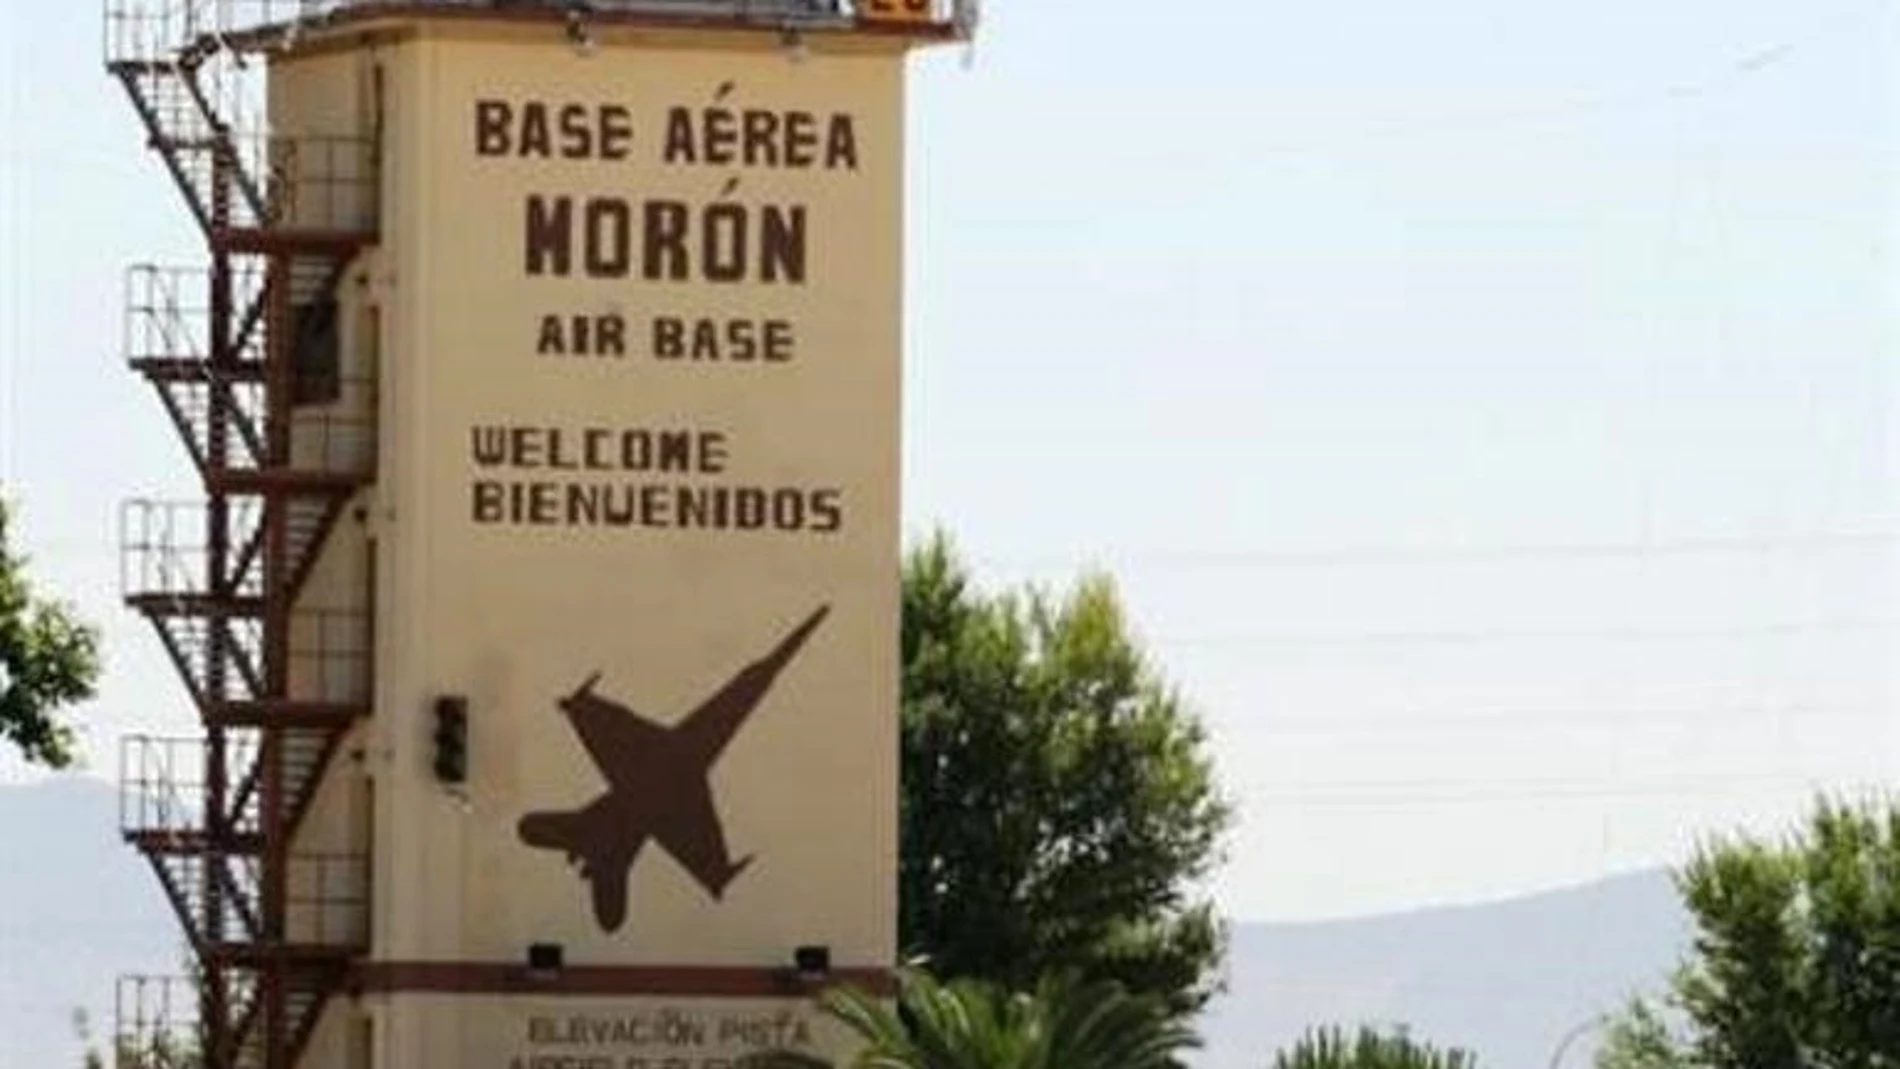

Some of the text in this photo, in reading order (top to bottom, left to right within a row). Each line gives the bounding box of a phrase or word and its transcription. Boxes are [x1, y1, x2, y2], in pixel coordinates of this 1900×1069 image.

[474, 81, 858, 169] BASE AÉREA
[525, 177, 806, 284] MORÓN
[537, 313, 795, 362] AIR BASE
[472, 426, 729, 474] WELCOME
